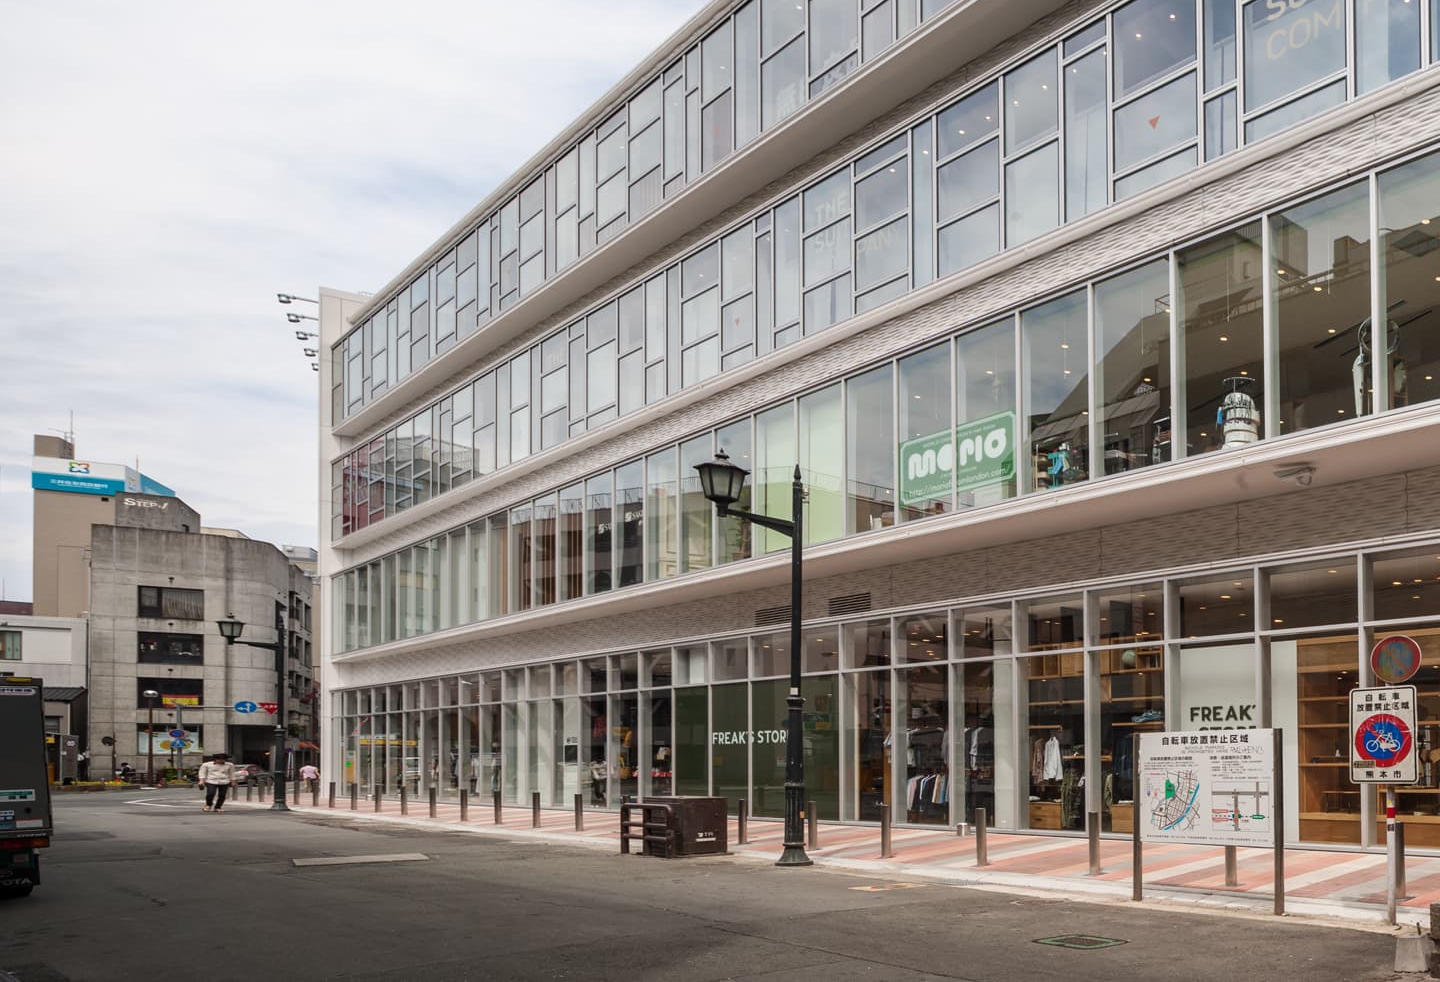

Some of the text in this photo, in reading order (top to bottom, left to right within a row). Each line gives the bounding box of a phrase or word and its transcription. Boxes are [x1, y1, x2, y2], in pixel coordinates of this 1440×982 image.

[1365, 693, 1400, 702] 自転車
[1190, 704, 1256, 722] FREAK'
[1357, 702, 1410, 712] 放置禁止区域
[757, 729, 789, 744] STOR
[1162, 734, 1249, 746] 自転車放置禁止区域
